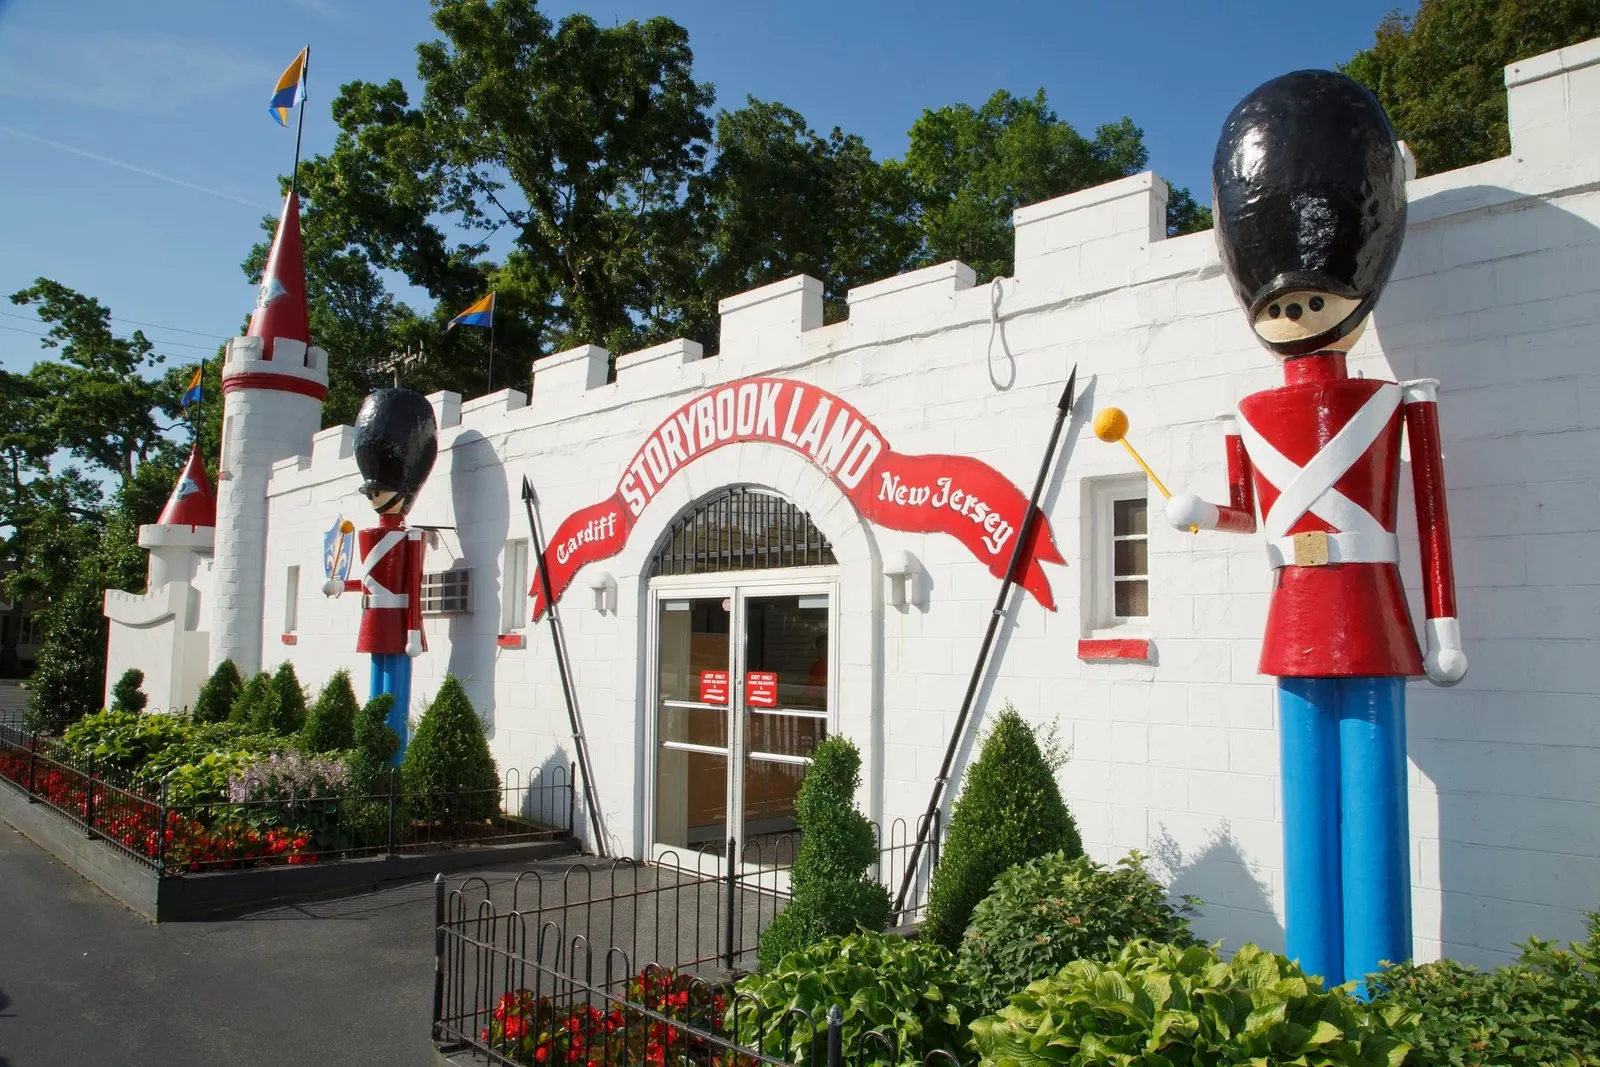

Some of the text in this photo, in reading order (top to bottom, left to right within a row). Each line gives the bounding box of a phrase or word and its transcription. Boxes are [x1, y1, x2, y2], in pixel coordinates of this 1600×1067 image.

[619, 383, 882, 517] STORYBOOK LAND
[556, 512, 617, 565] Cardiff
[878, 471, 1014, 554] New Jersey
